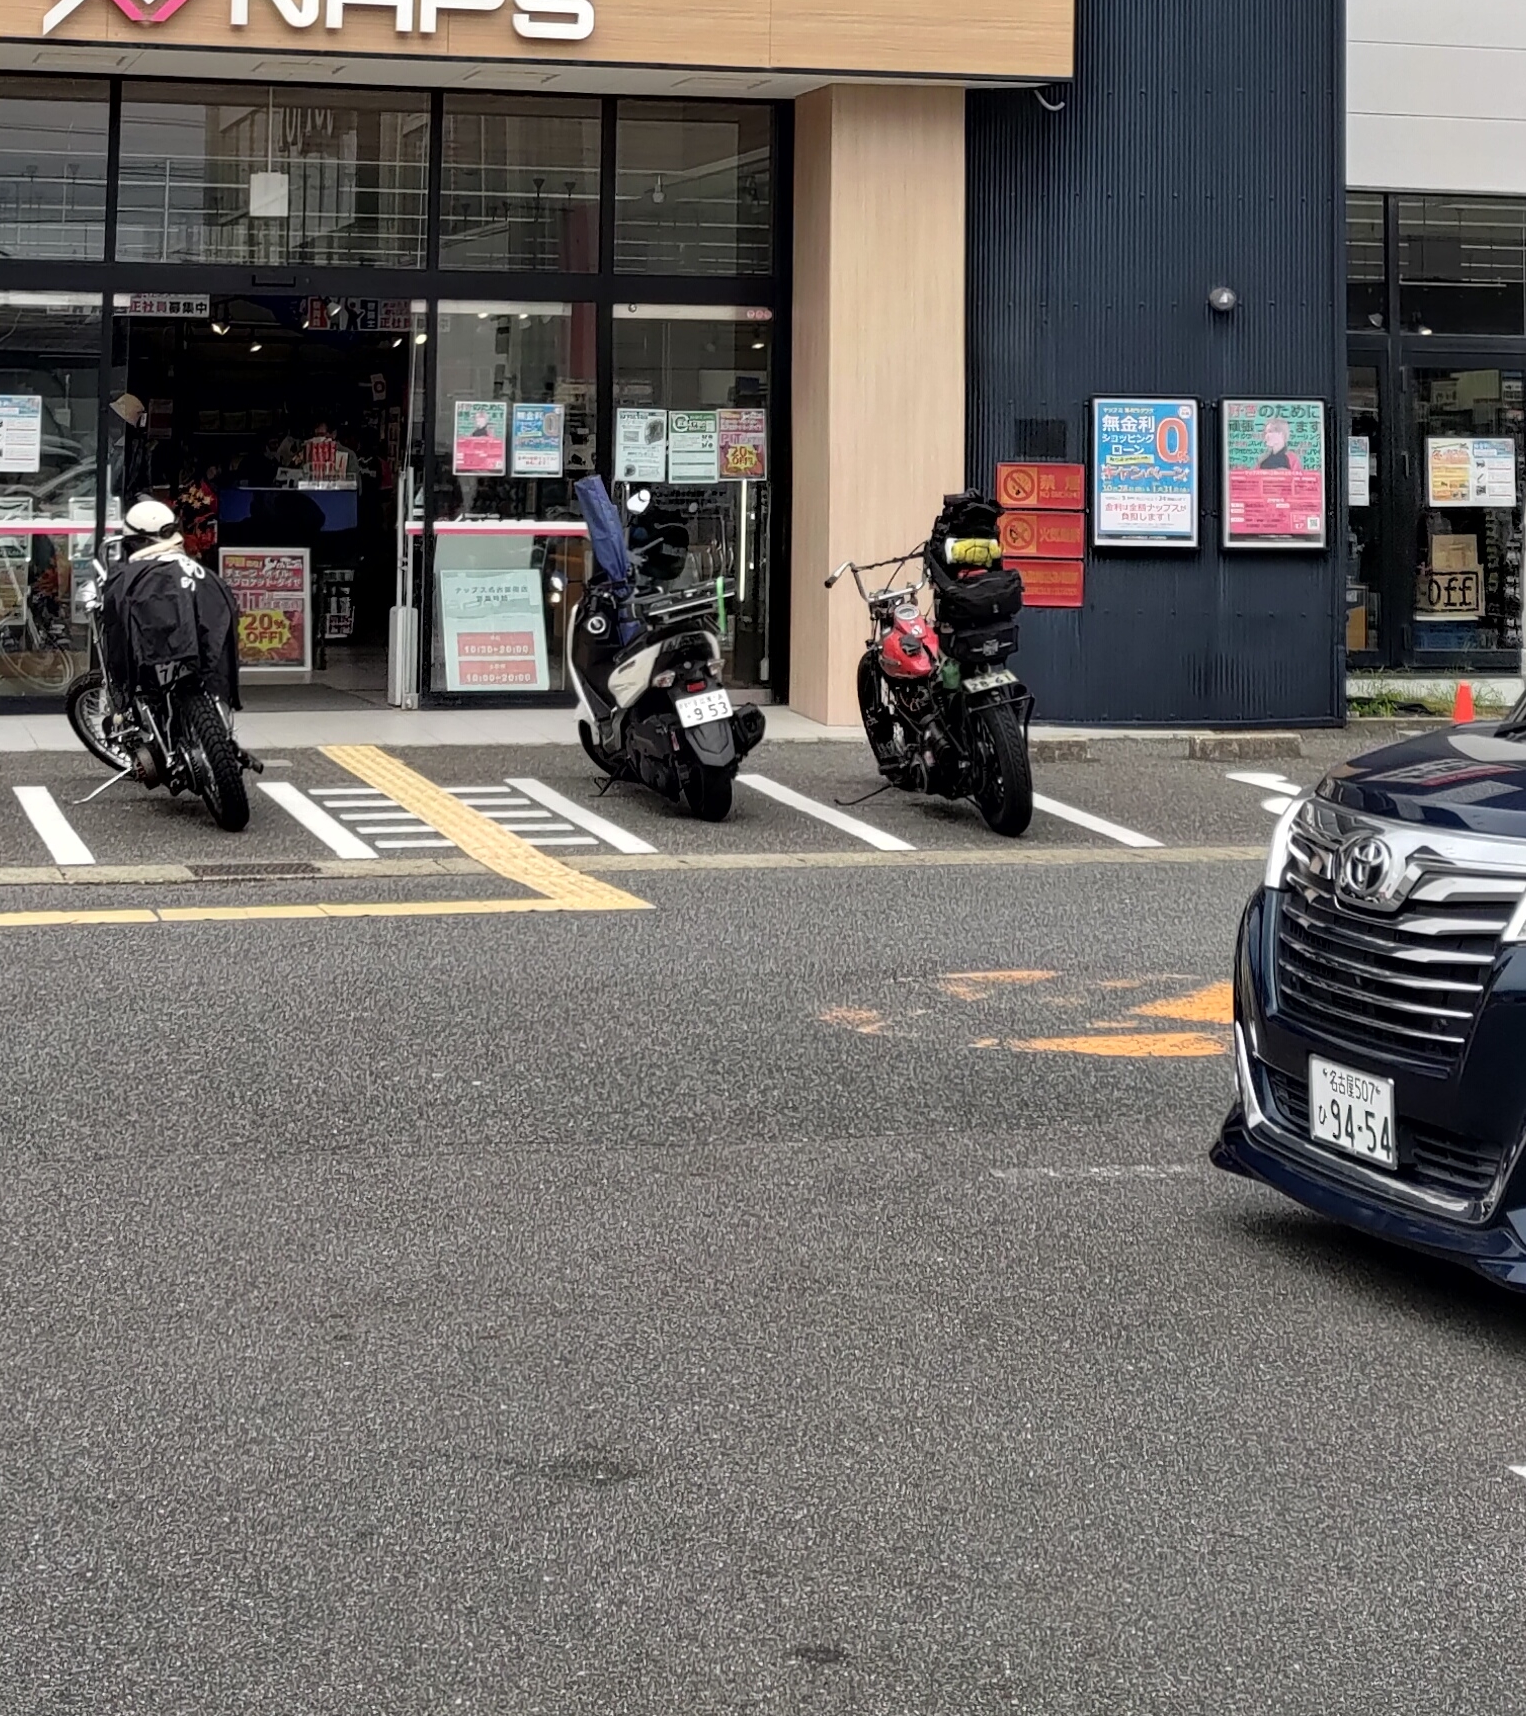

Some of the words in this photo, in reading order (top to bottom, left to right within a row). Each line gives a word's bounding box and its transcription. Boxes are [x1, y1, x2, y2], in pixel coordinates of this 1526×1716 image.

[1101, 415, 1155, 433] 無金利
[1101, 434, 1155, 443] ショッピング
[1111, 445, 1145, 455] ローン
[1331, 1099, 1392, 1160] 94-54
